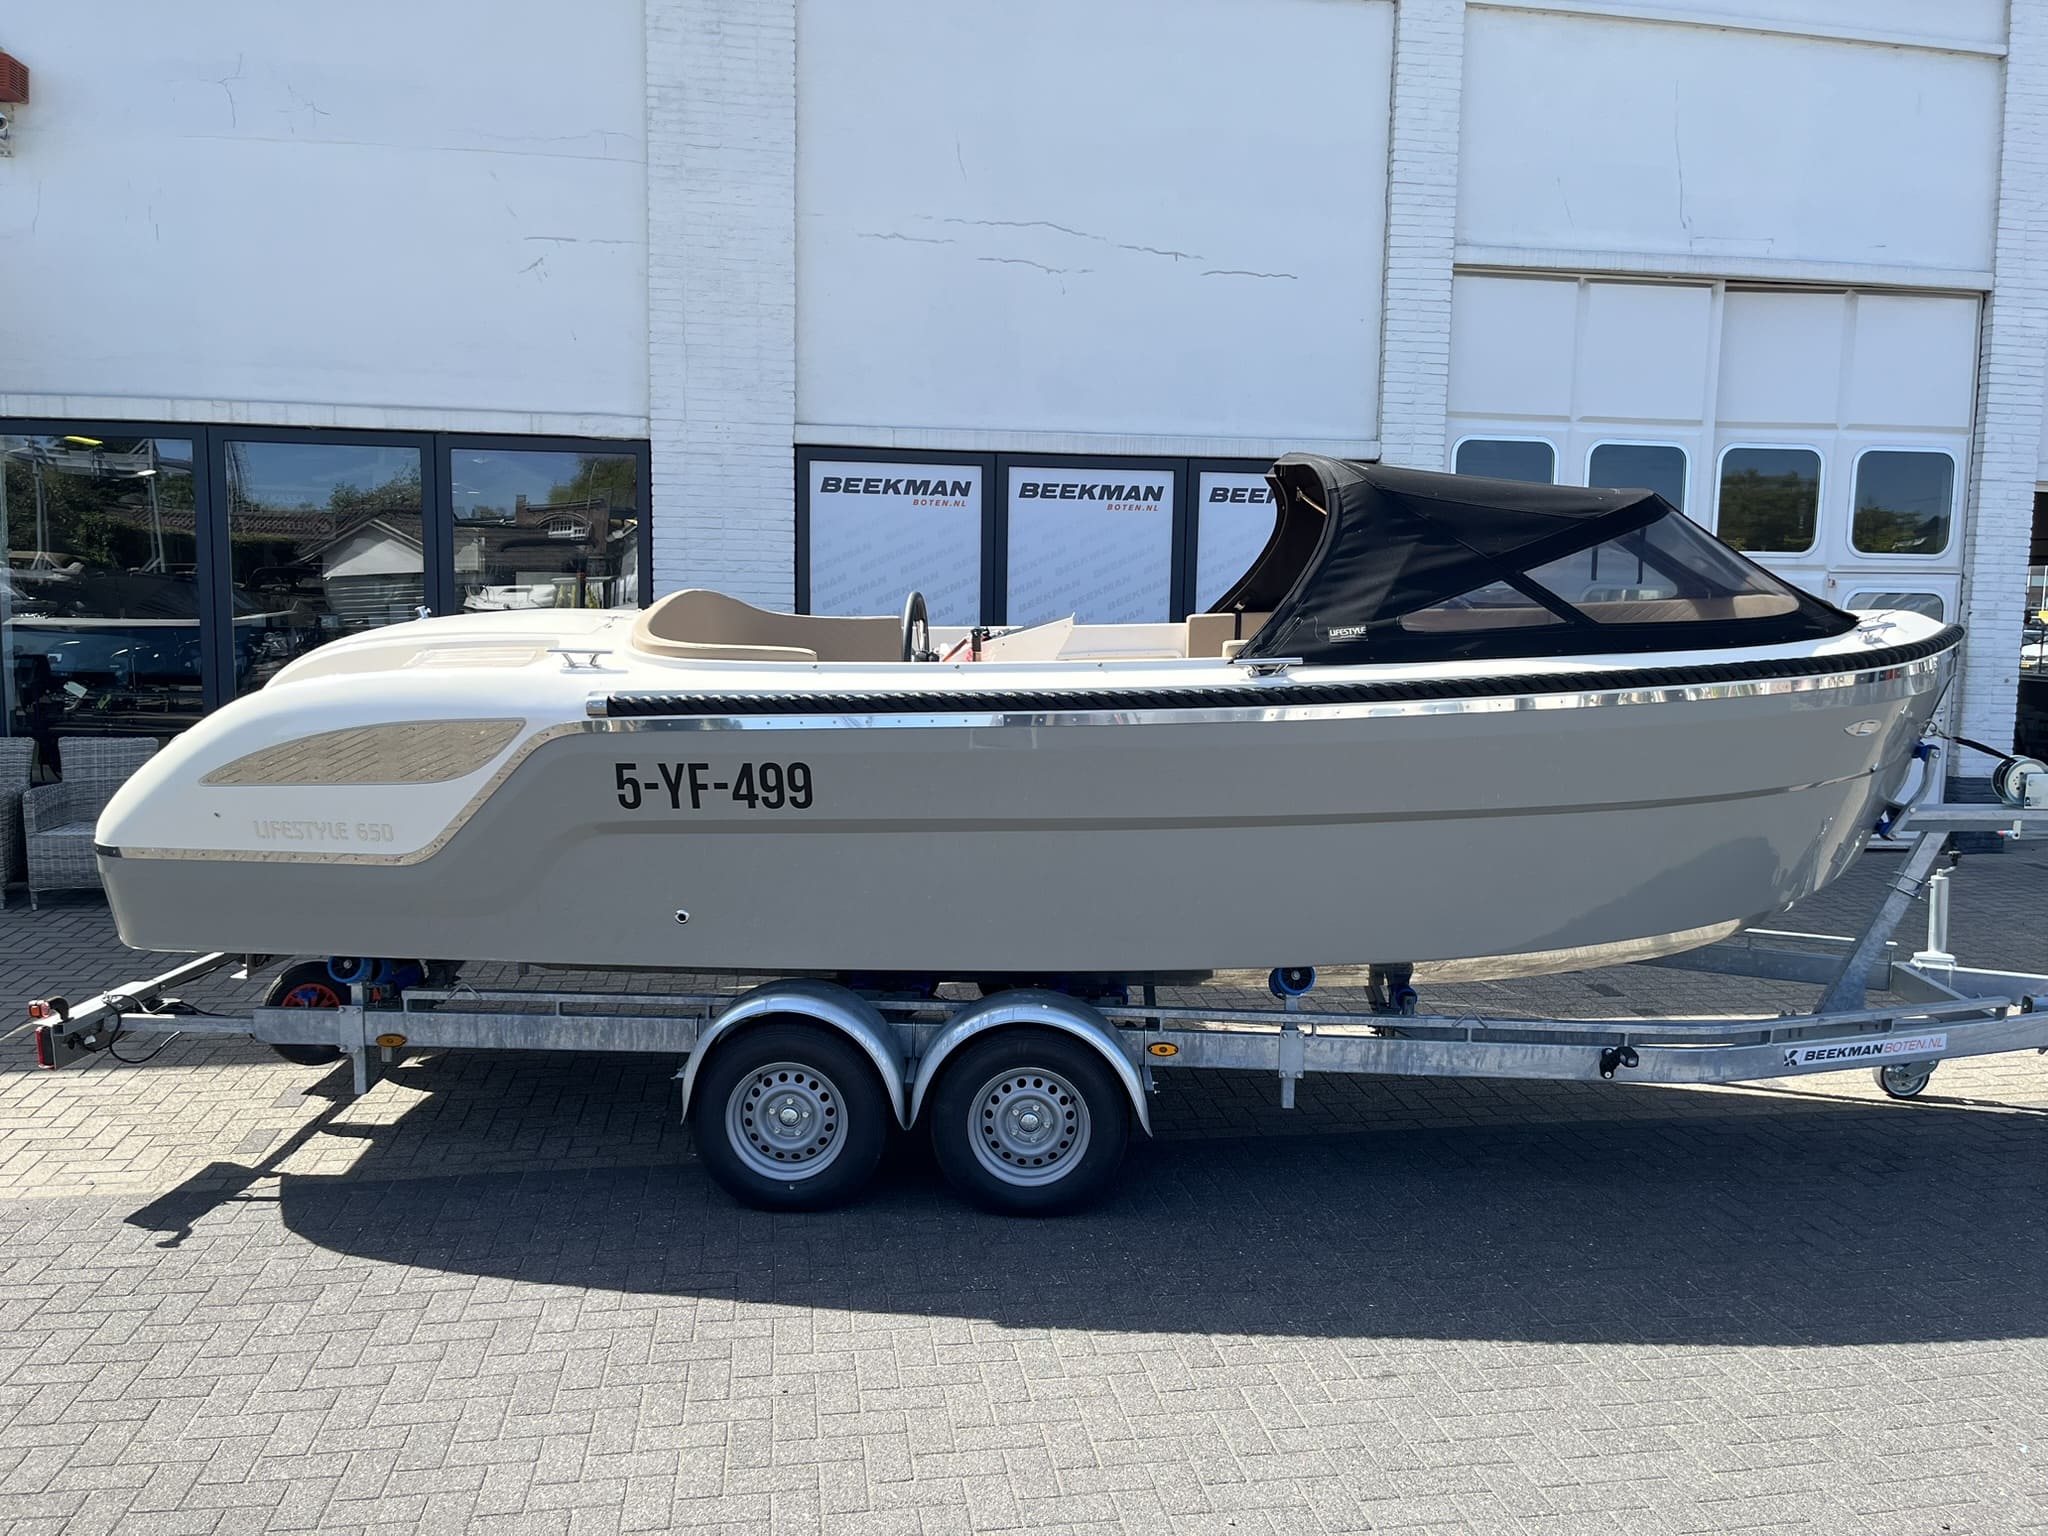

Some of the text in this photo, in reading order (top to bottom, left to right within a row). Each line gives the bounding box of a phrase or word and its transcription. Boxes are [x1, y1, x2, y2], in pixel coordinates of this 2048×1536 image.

[820, 477, 972, 497] BEEKMAN
[1018, 482, 1165, 502] BEEKMAN
[912, 499, 967, 508] BOTEN.NL
[1106, 503, 1159, 512] BOTEN.NL
[1329, 626, 1367, 637] LIFESTYLE
[615, 762, 814, 810] 5-YF-499
[253, 820, 395, 842] LIFESTYLE 650
